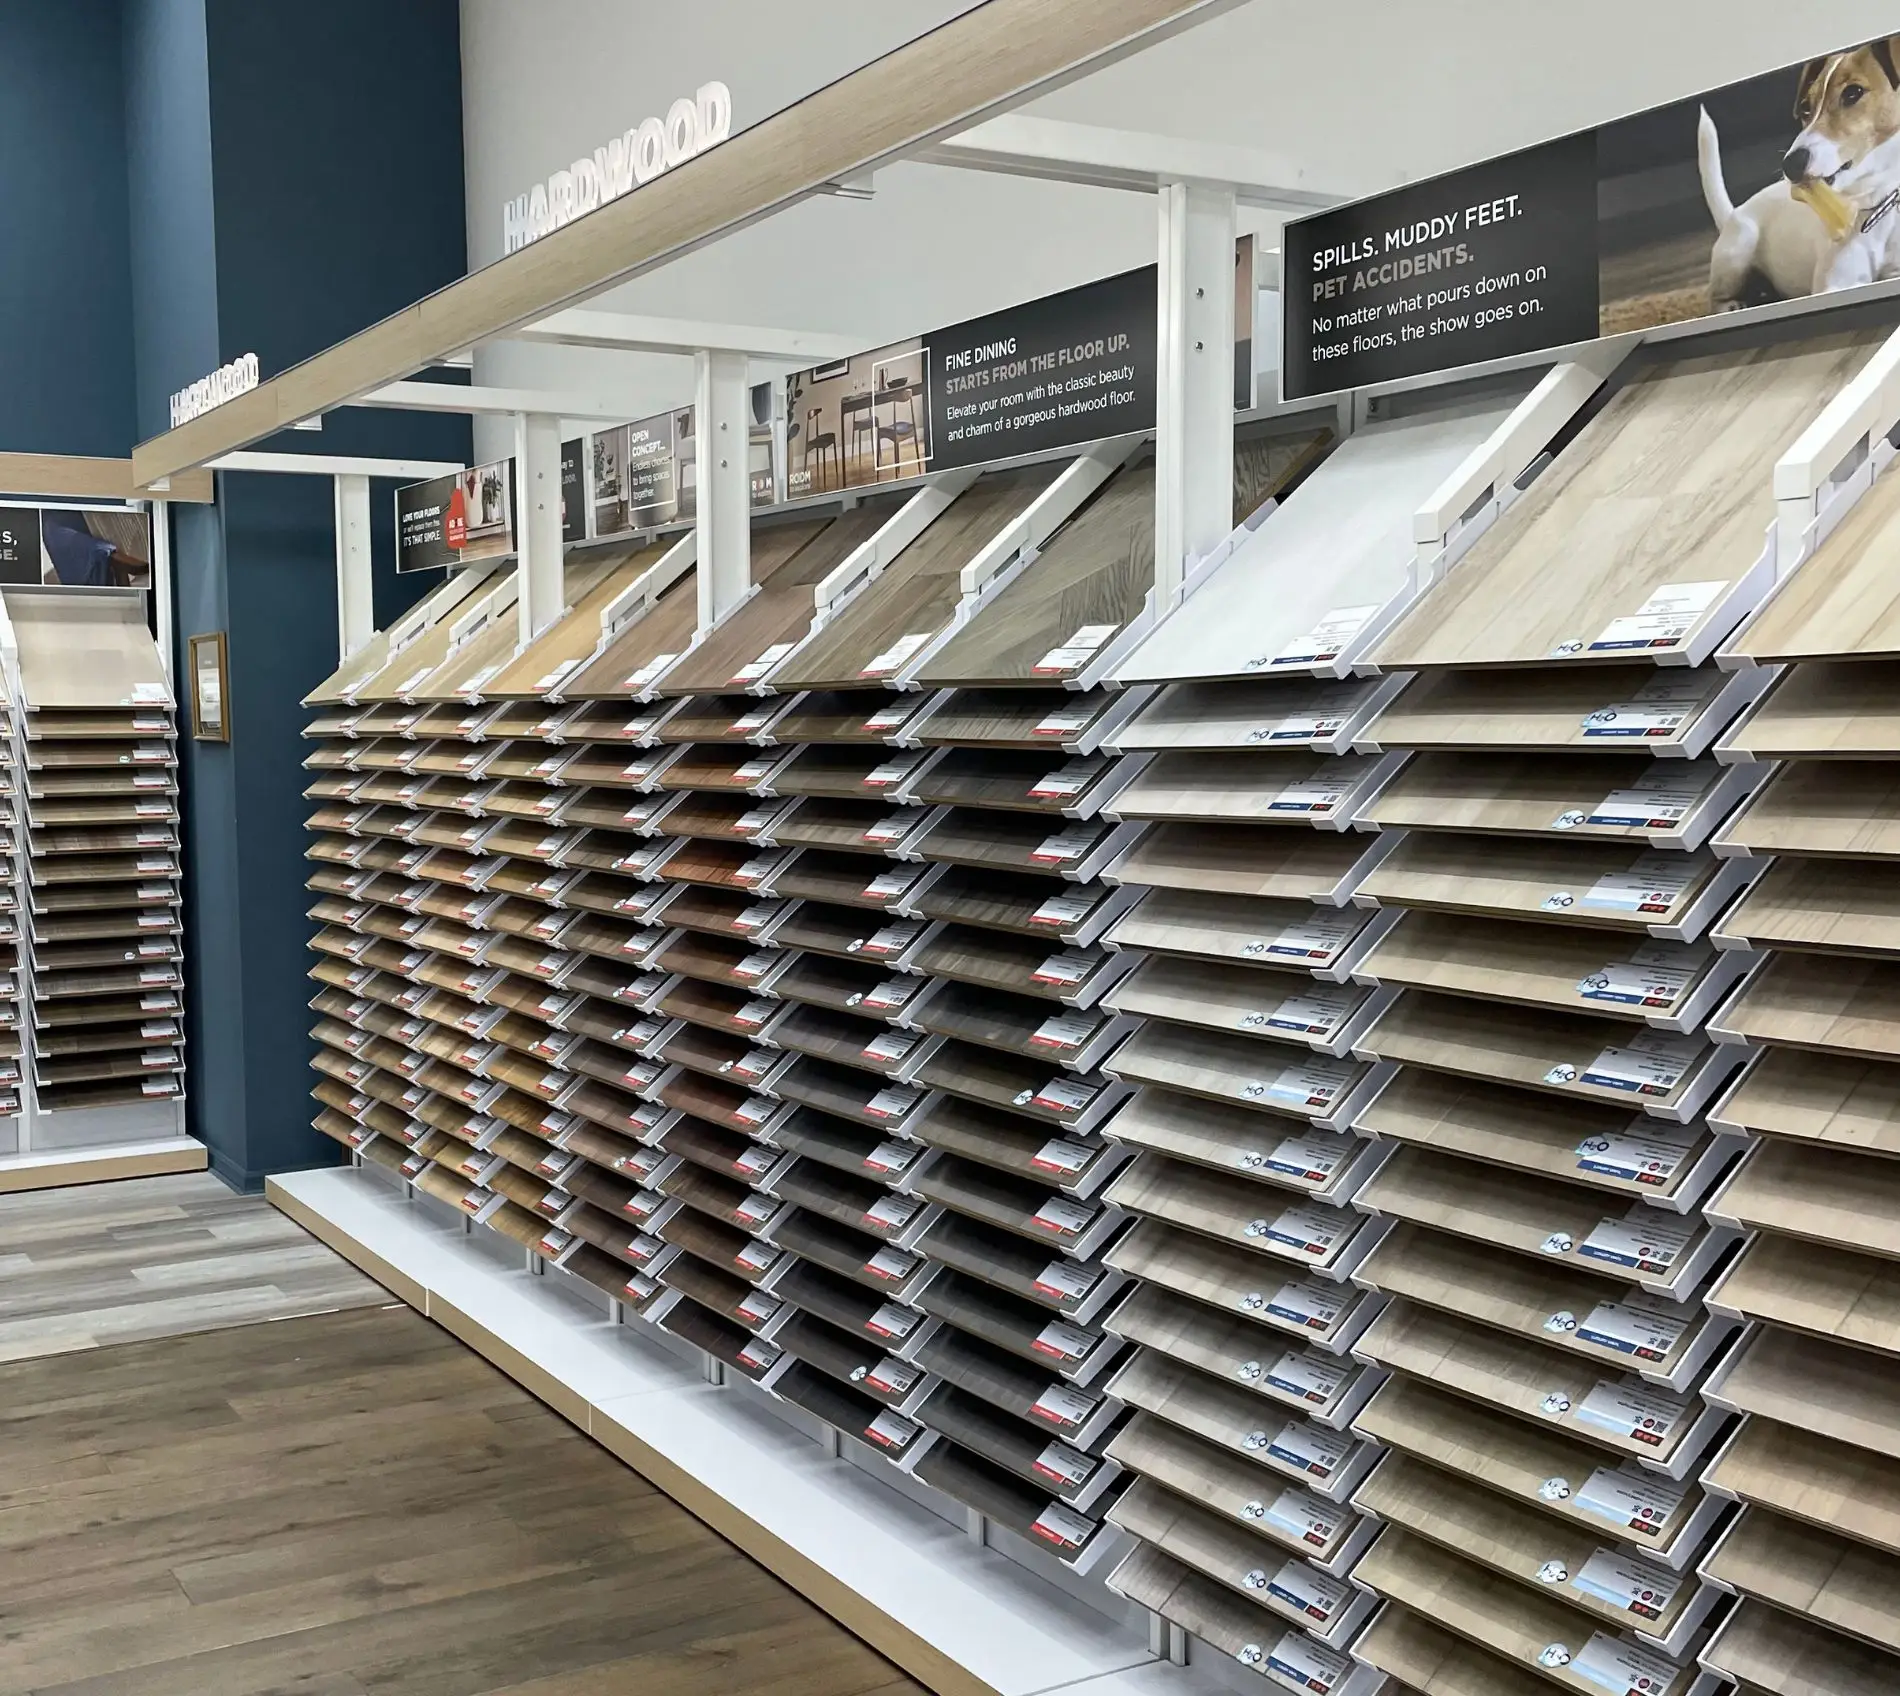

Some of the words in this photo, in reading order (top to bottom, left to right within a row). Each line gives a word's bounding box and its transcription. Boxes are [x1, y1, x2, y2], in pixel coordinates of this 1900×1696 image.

[503, 81, 731, 255] HARDWOOD
[1313, 237, 1379, 272] SPILLS.
[1385, 212, 1459, 252] MUDDY
[1465, 195, 1523, 230] FEET.
[1313, 275, 1348, 302] PET
[1353, 243, 1474, 293] ACCIDENTS.
[1313, 317, 1332, 335] No
[1336, 305, 1382, 330] matter
[1387, 293, 1422, 317] what
[1427, 282, 1471, 308] pours
[1475, 270, 1520, 296] down
[1525, 264, 1547, 283] on
[945, 352, 972, 372] FINE
[974, 337, 1017, 365] DINING
[1312, 342, 1349, 363] these
[1352, 331, 1397, 353] floors,
[1401, 322, 1425, 342] the
[1429, 313, 1470, 337] show
[1474, 304, 1513, 330] goes
[1518, 297, 1544, 317] on.
[946, 370, 990, 396] STARTS
[992, 361, 1028, 386] FROM
[1030, 354, 1056, 376] THE
[1058, 341, 1105, 370] FLOOR
[1108, 332, 1131, 355] UP.
[947, 401, 977, 420] Elevate
[978, 398, 998, 417] your
[1000, 392, 1024, 408] room
[1026, 384, 1046, 402] with
[1047, 380, 1064, 397] the
[1065, 371, 1097, 393] classic
[1099, 364, 1136, 388] beauty
[632, 429, 649, 443] OPEN
[948, 424, 964, 442] and
[965, 418, 993, 437] charm
[994, 415, 1004, 432] of
[1005, 419, 1012, 430] a
[1013, 406, 1057, 431] gorgeous
[1058, 395, 1108, 418] hardwood
[1109, 388, 1136, 408] floor.
[633, 477, 639, 486] to
[639, 474, 652, 485] bring
[789, 470, 811, 485] ROOM
[0, 530, 18, 546] S,
